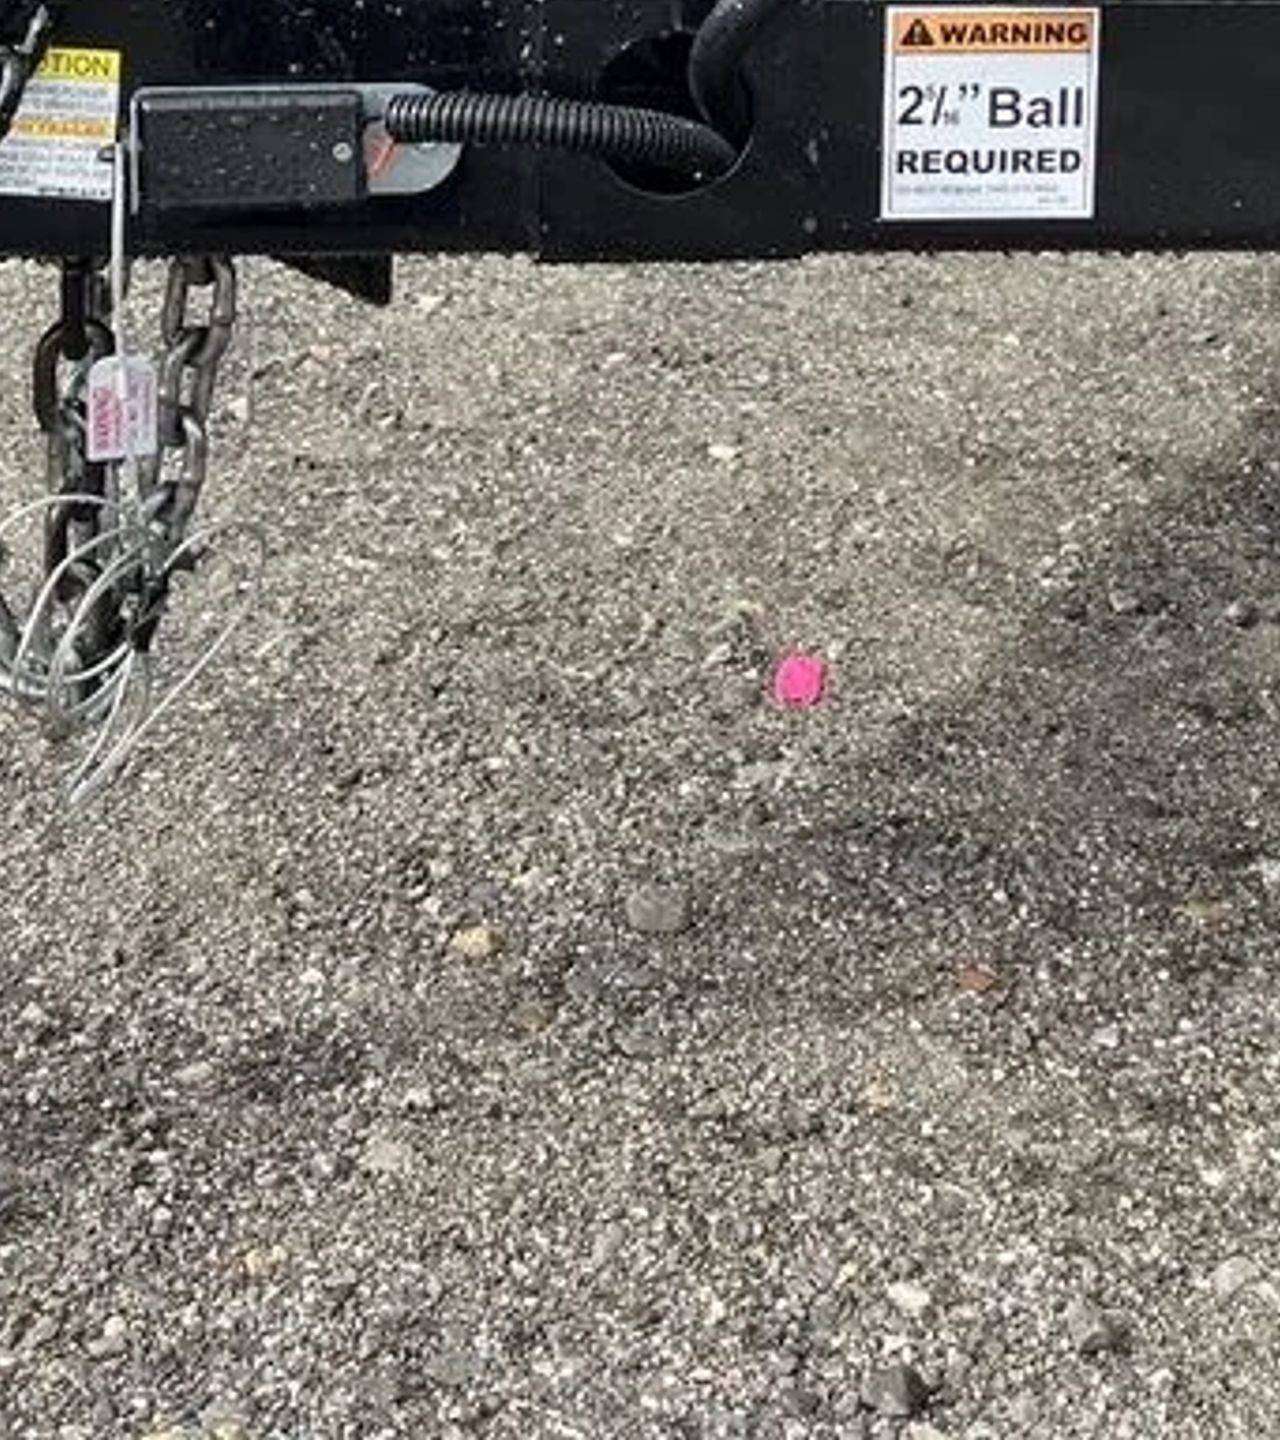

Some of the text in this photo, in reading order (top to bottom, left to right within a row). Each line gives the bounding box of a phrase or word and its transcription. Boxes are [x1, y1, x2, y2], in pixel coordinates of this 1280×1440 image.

[940, 22, 1088, 44] WARNING
[40, 53, 112, 76] TION
[988, 86, 1083, 128] Ball
[896, 149, 1081, 175] REQUIRED
